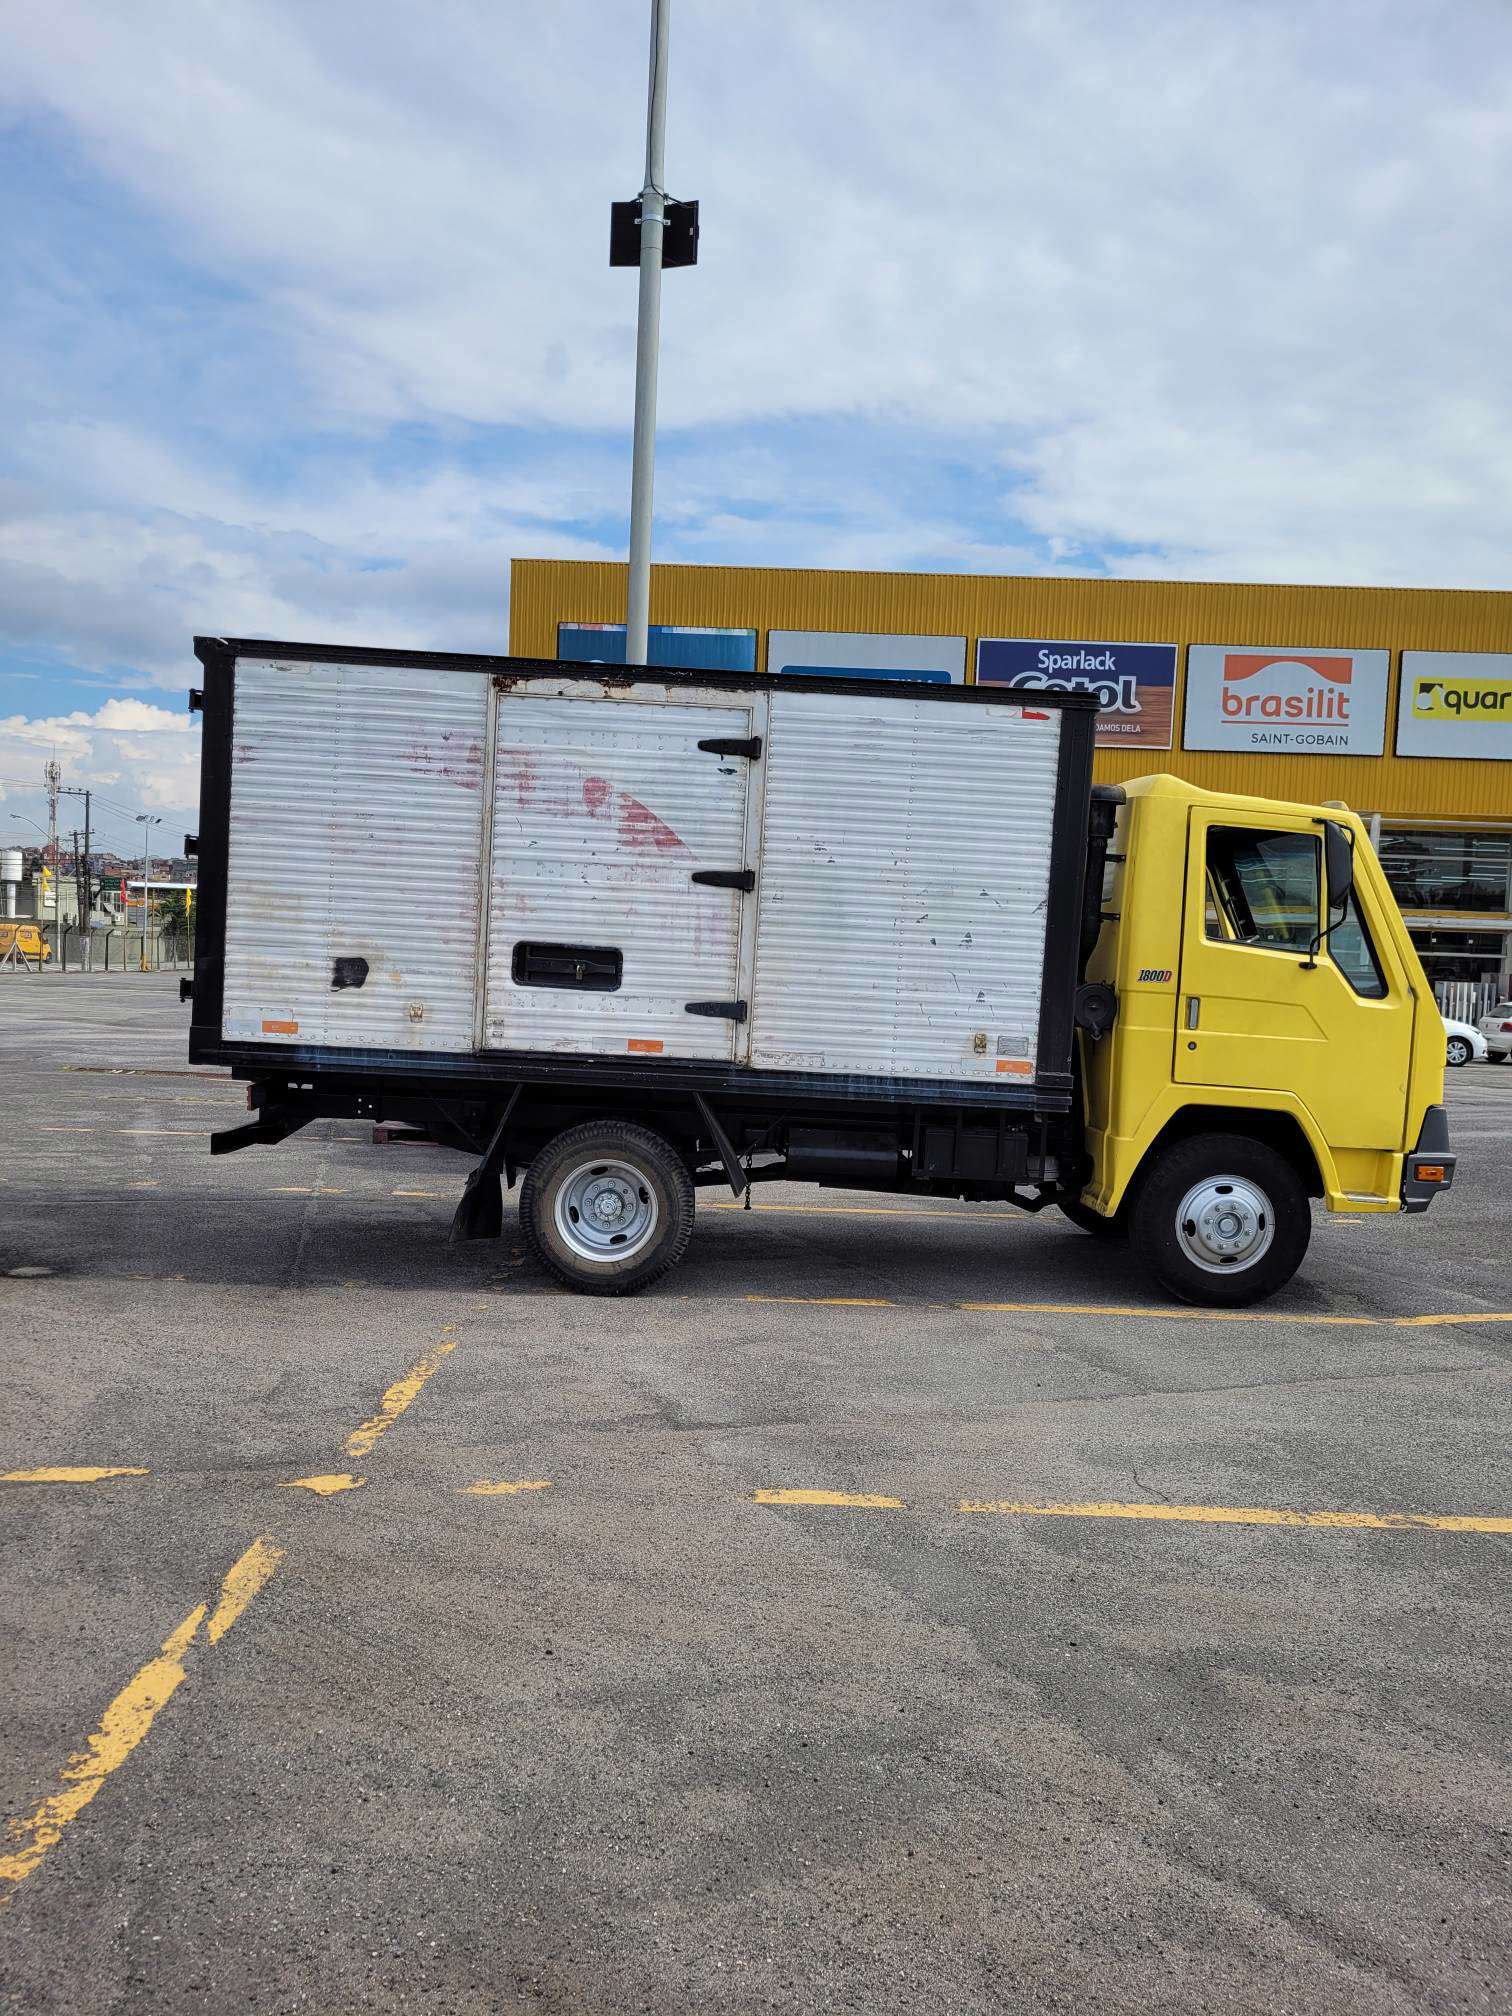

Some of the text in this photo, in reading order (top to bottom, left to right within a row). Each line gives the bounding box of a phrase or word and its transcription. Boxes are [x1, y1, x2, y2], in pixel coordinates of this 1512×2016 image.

[1037, 650, 1116, 673] Sparlack
[1221, 686, 1351, 719] brasilit
[1443, 689, 1512, 715] quar
[1121, 724, 1141, 733] DELA
[1250, 732, 1349, 746] SAINT-GOBAIN
[1137, 969, 1173, 982] 1800D
